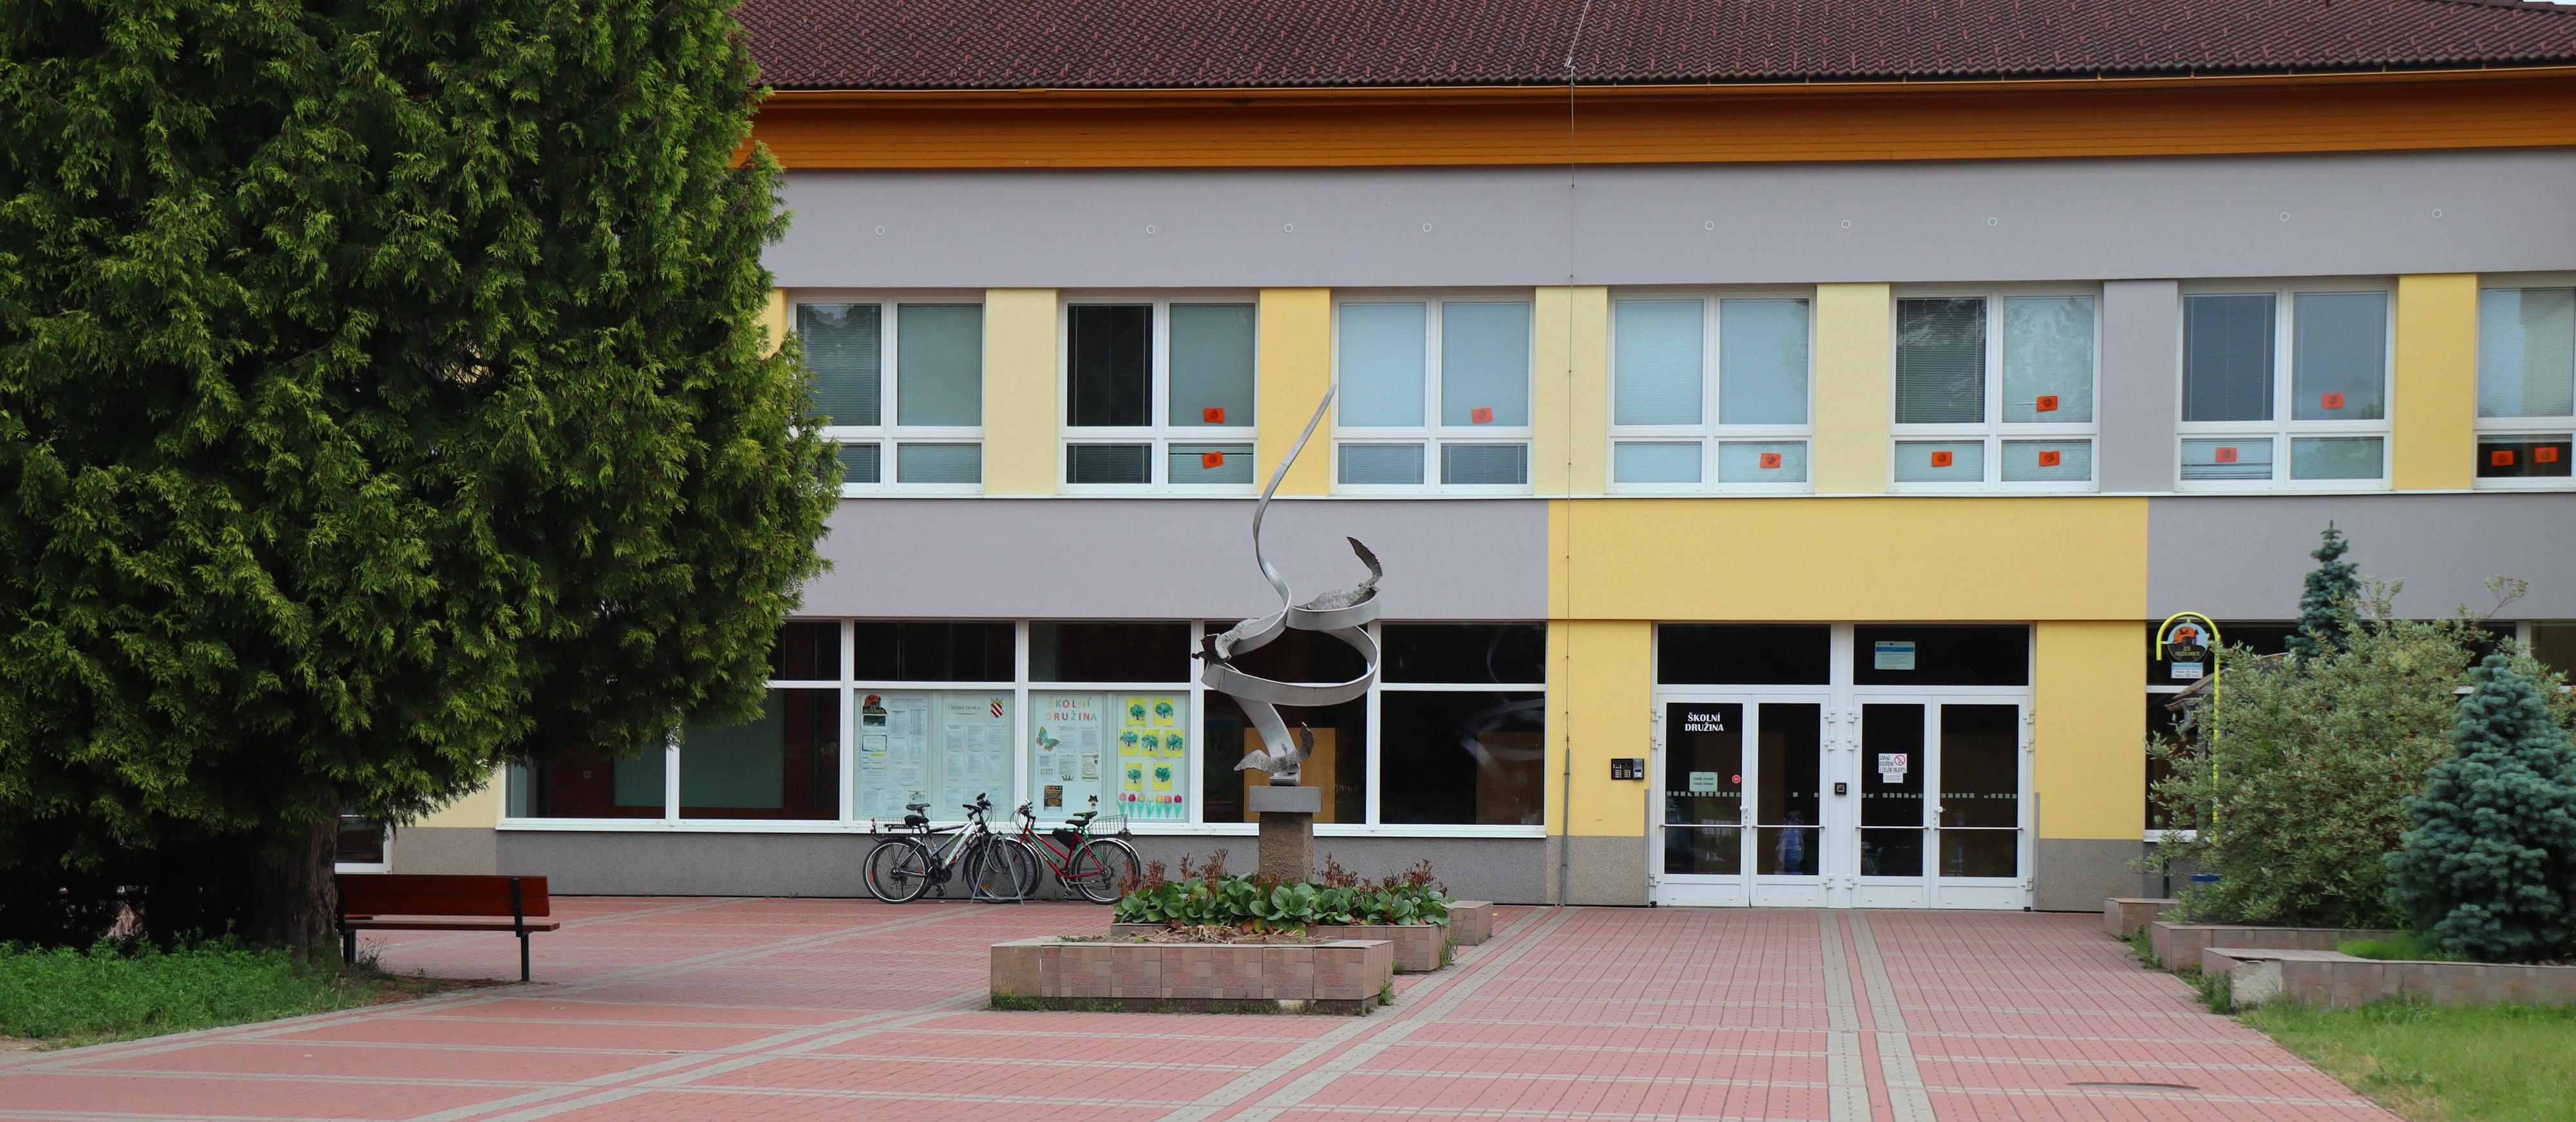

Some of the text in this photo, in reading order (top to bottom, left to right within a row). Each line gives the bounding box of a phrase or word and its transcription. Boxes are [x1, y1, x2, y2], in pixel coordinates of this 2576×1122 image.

[1048, 696, 1092, 708] ŠKOLNÍ
[1045, 710, 1097, 721] DRUŽINA
[1687, 712, 1721, 722] ŠKOLNÍ
[1685, 722, 1724, 732] DRUŽINA
